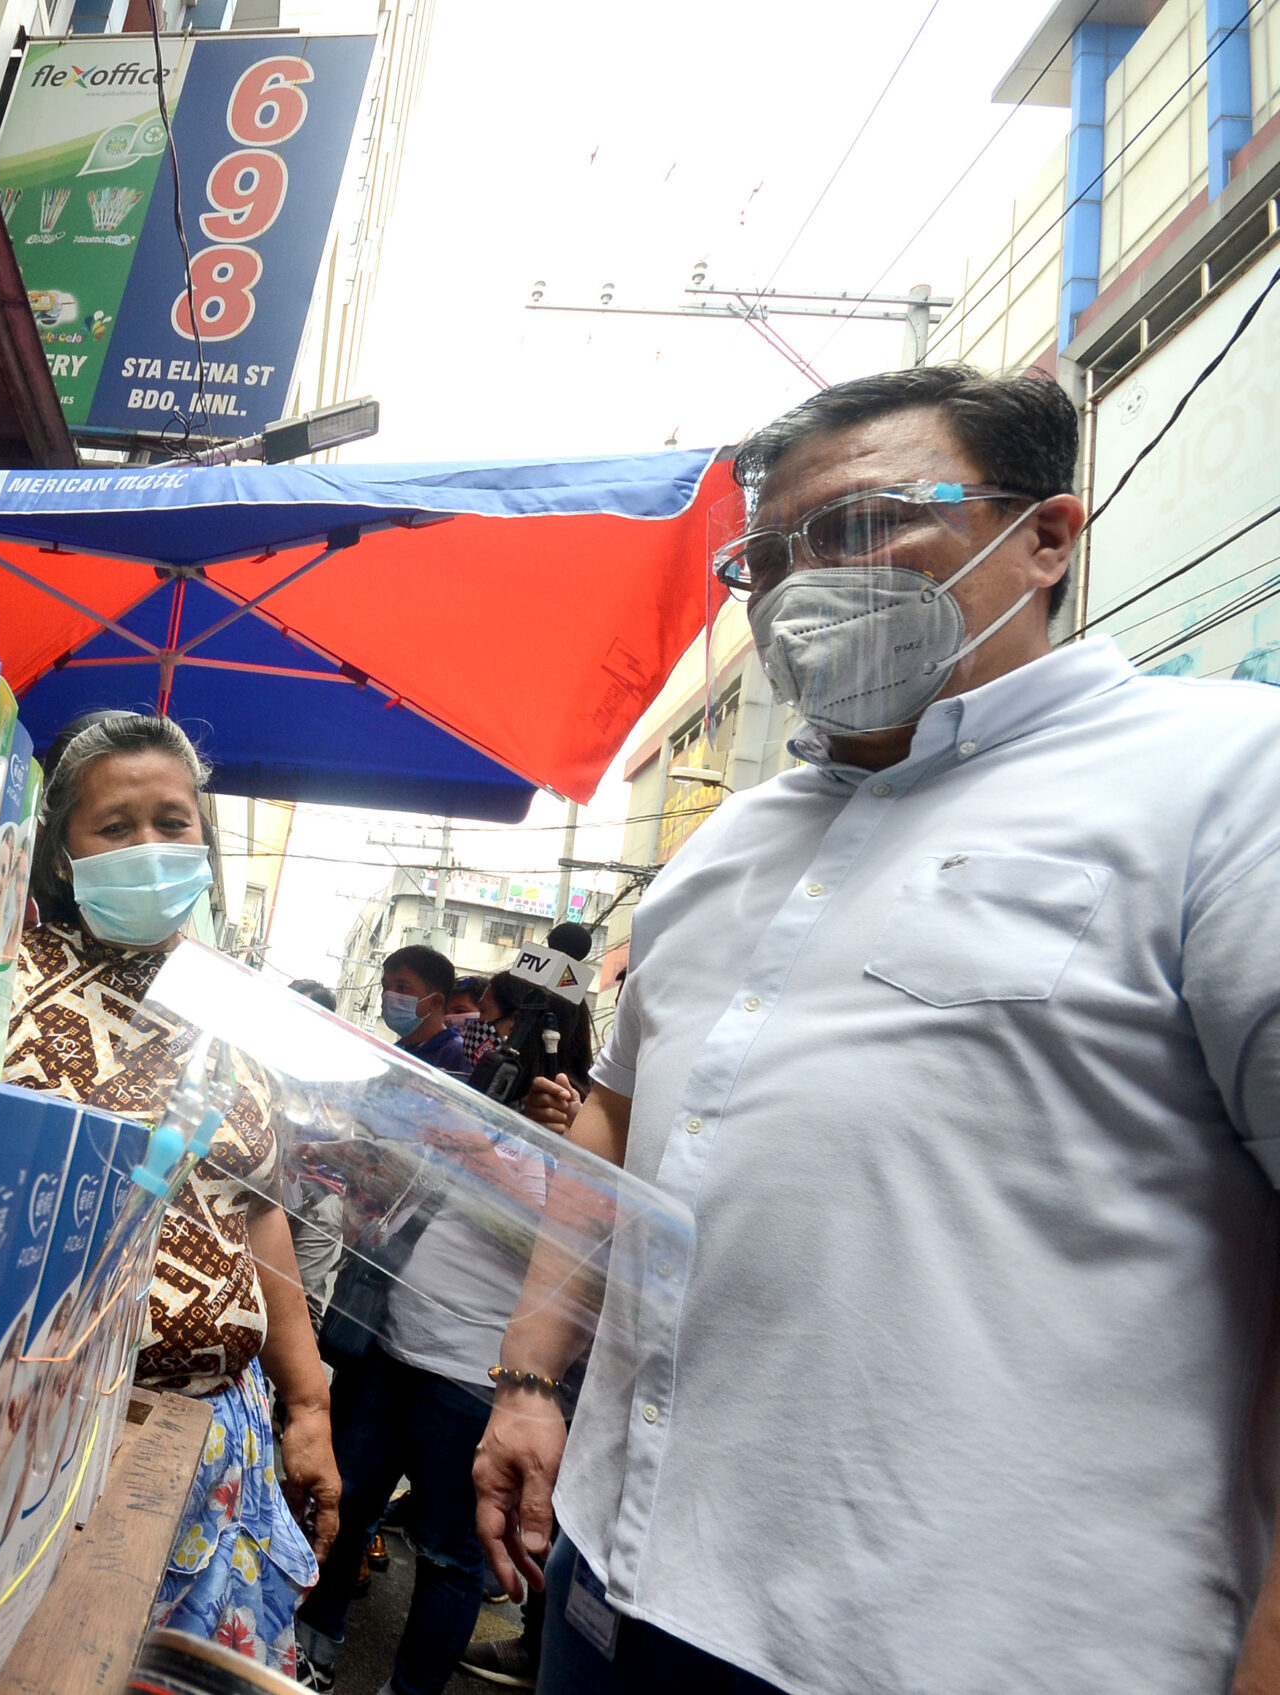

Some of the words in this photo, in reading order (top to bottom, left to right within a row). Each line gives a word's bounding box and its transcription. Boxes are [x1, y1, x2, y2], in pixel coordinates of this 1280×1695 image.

[170, 55, 315, 343] 698
[121, 357, 162, 380] STA
[167, 360, 238, 384] ELENA
[243, 365, 275, 386] ST
[127, 389, 180, 412] BDO.
[115, 469, 189, 491] matic
[516, 952, 551, 973] PTV
